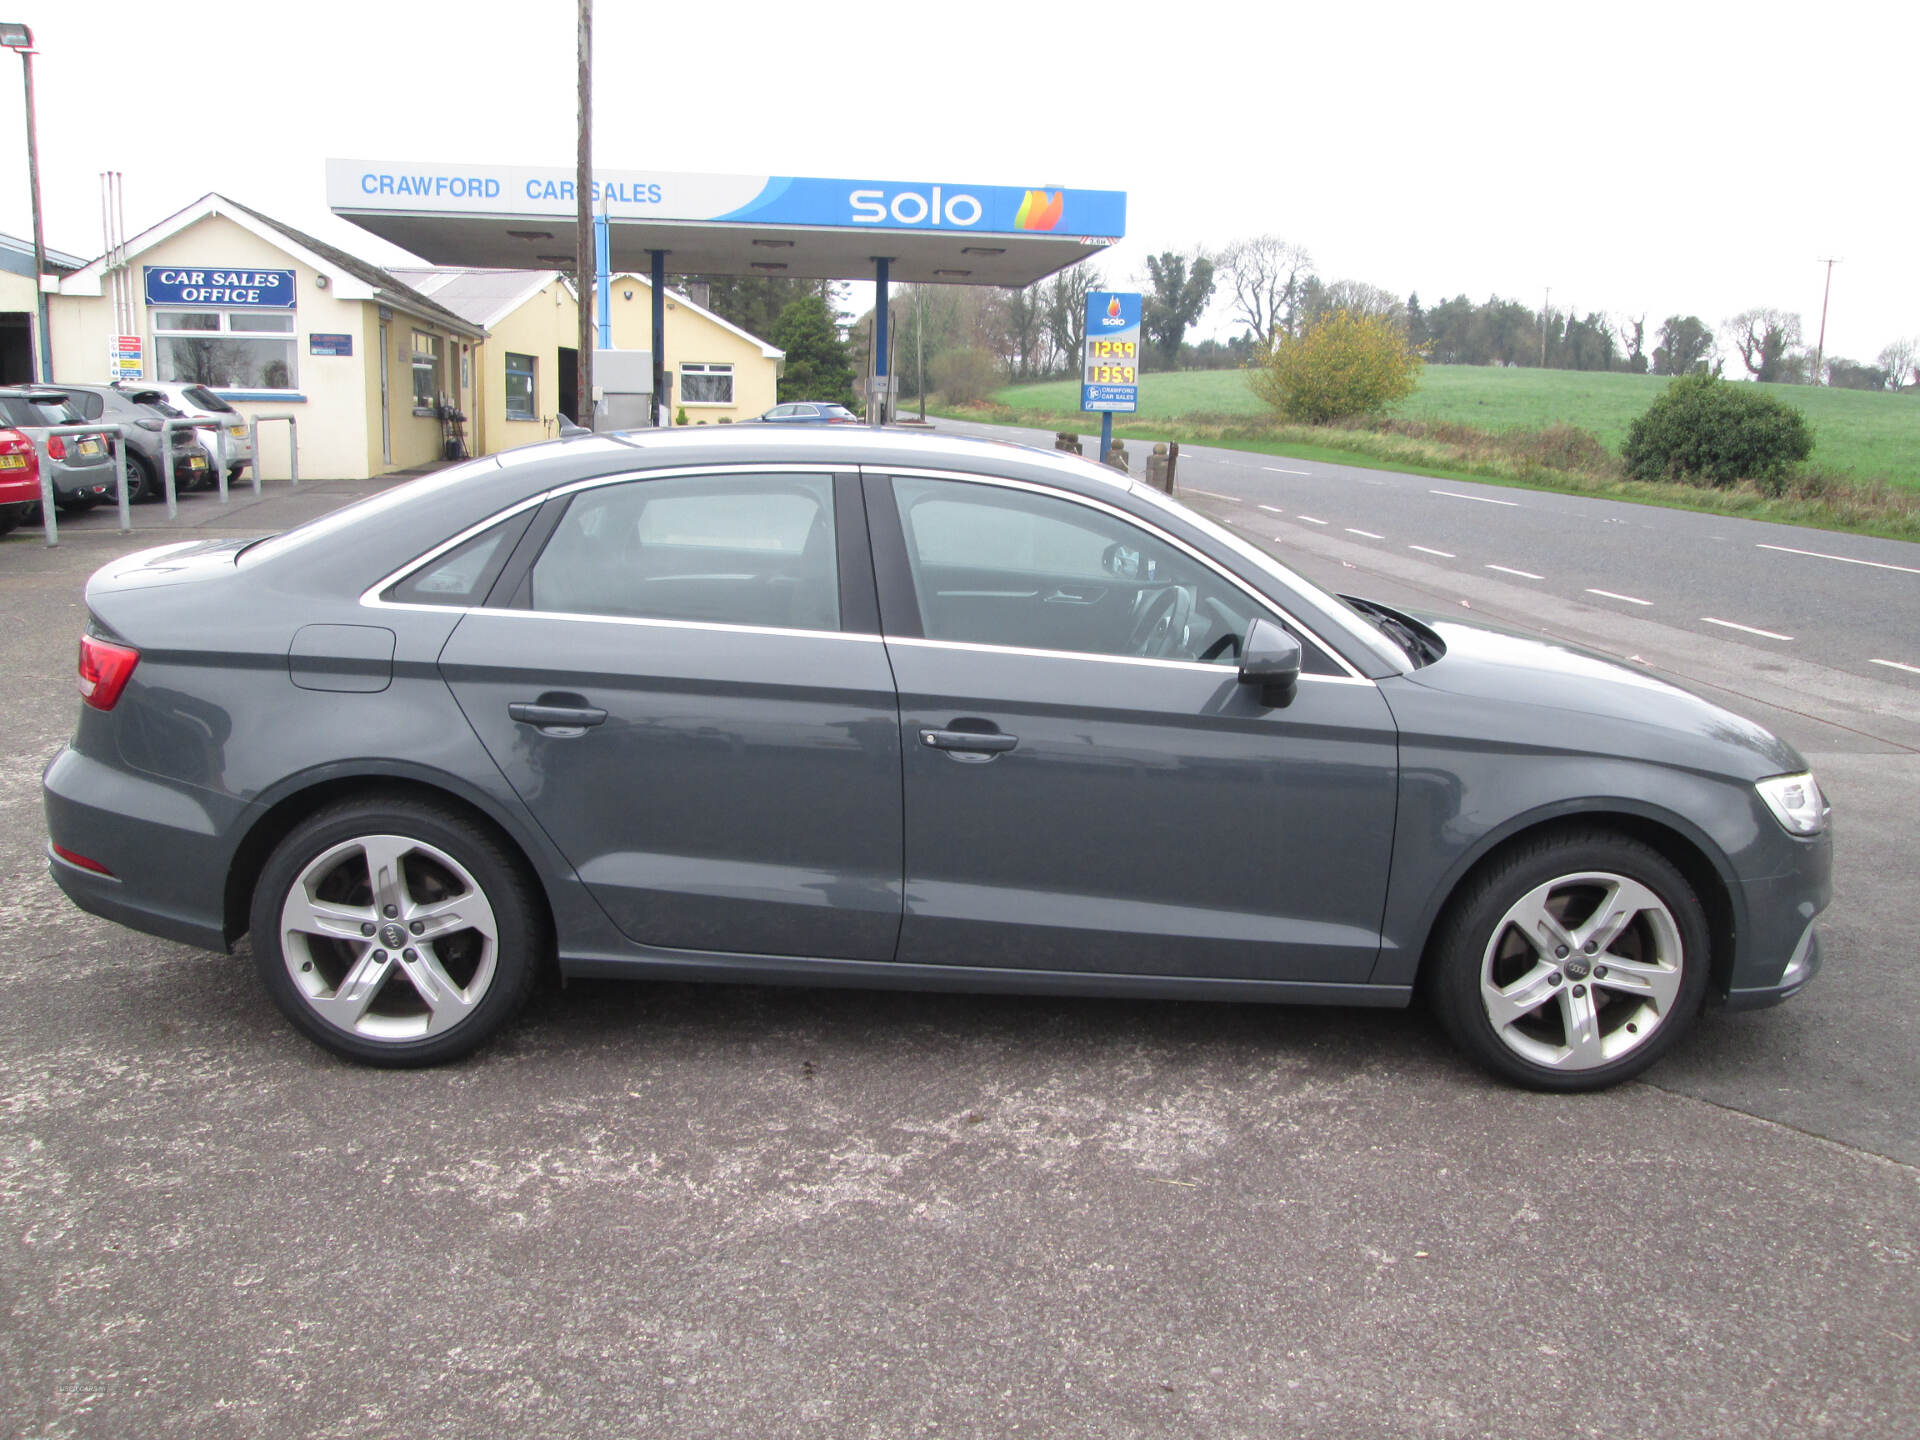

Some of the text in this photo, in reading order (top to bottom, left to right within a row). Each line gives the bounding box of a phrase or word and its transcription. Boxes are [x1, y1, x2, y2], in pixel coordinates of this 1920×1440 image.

[361, 174, 500, 198] CRAWFORD
[525, 179, 578, 201] CAR
[848, 186, 983, 226] solo
[160, 271, 280, 287] CAR SALES
[182, 287, 260, 303] OFFICE
